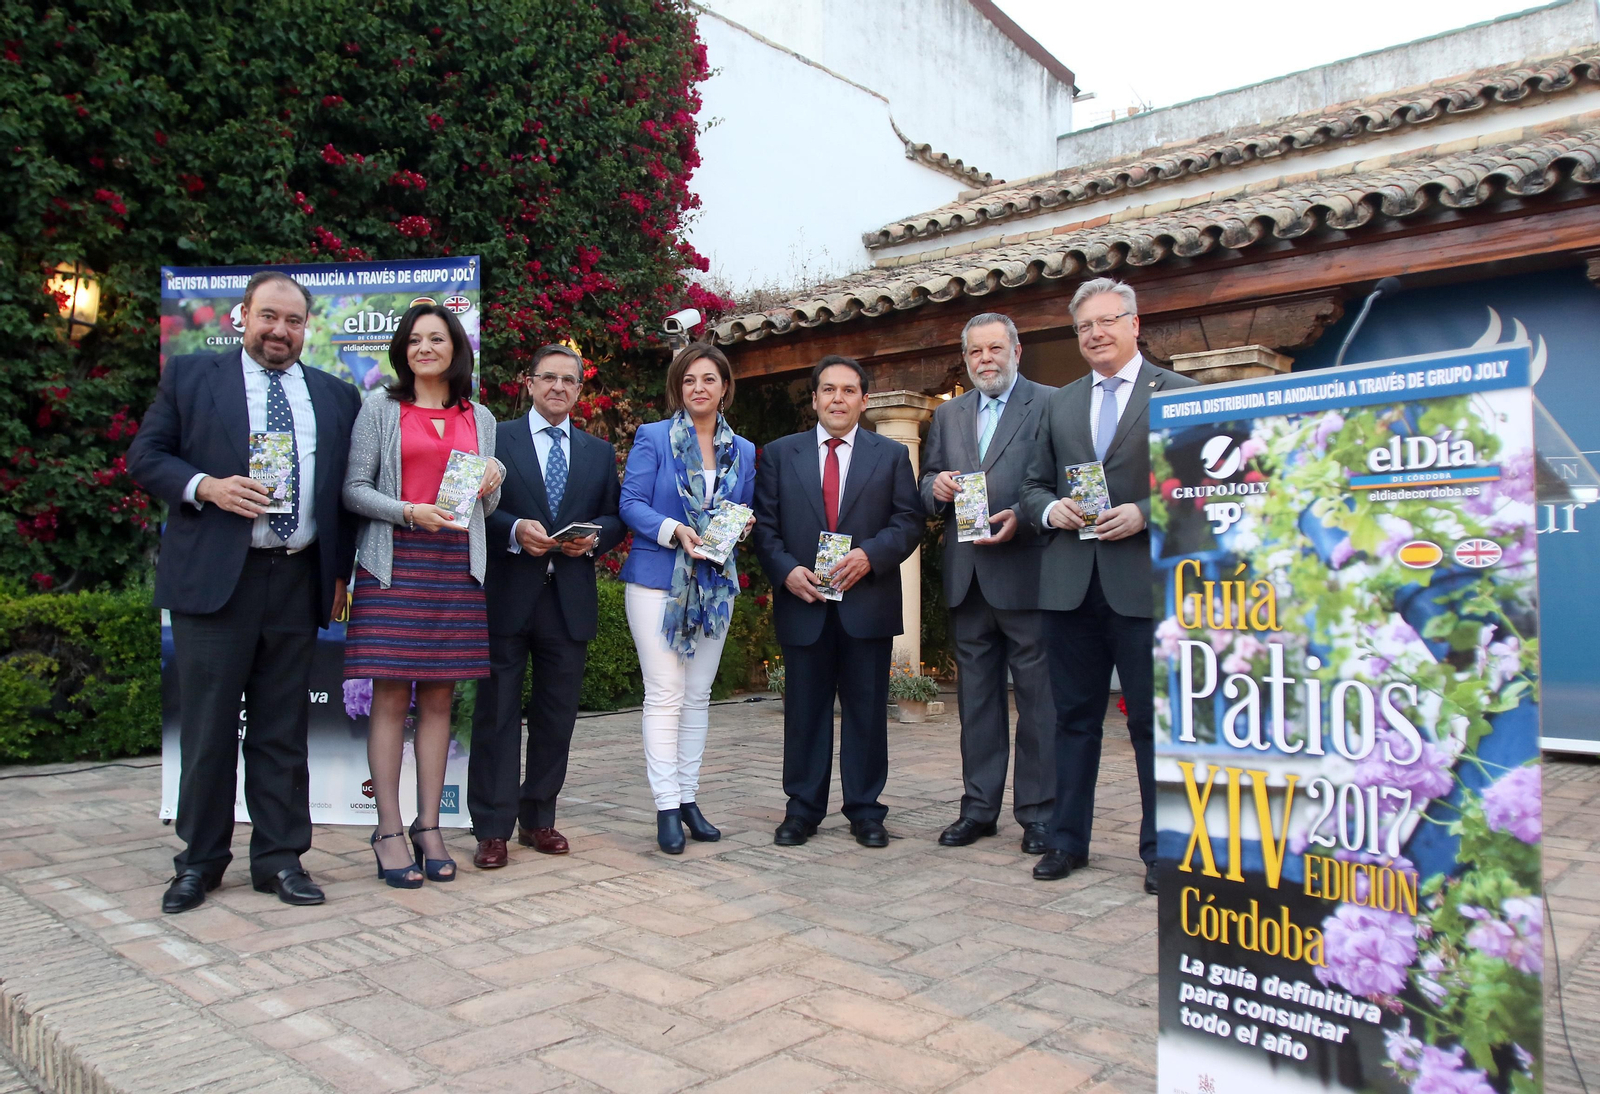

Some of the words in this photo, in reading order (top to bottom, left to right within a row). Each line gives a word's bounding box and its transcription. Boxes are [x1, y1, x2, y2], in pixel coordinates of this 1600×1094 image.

[168, 276, 208, 290] REVISTA
[211, 275, 251, 289] DISTRIB
[347, 272, 355, 285] A
[357, 268, 395, 285] TRAVÉS
[398, 270, 410, 283] DE
[413, 269, 448, 283] GRUPO
[451, 267, 475, 281] JOLY
[207, 337, 244, 345] GRUPO
[343, 344, 390, 352] eldiadecordo
[1162, 401, 1202, 419] REVISTA
[1204, 392, 1266, 414] DISTRIBUIDA
[1268, 390, 1282, 406] EN
[1284, 379, 1347, 404] ANDALUCÍA
[1348, 381, 1358, 396] A
[1358, 372, 1405, 395] TRAVÉS
[1407, 372, 1425, 389] DE
[1427, 365, 1472, 386] GRUPO
[1475, 360, 1509, 381] JOLY
[1369, 486, 1480, 501] eldiadecordoba.es
[1407, 473, 1452, 482] CÓRDOBA
[1174, 559, 1283, 632] Guía
[1178, 640, 1423, 766] Patios
[1178, 761, 1300, 890] XIV
[1306, 777, 1412, 858] 2017
[1303, 853, 1418, 917] EDICIÓN
[1179, 886, 1329, 969] Córdoba
[1179, 953, 1204, 977] La
[1207, 965, 1258, 991] guía
[1261, 975, 1382, 1024] definitiva
[1179, 982, 1230, 1010] para
[1233, 997, 1350, 1044] consultar
[1179, 1006, 1231, 1037] todo
[1235, 1024, 1259, 1046] el
[1262, 1032, 1308, 1061] año
